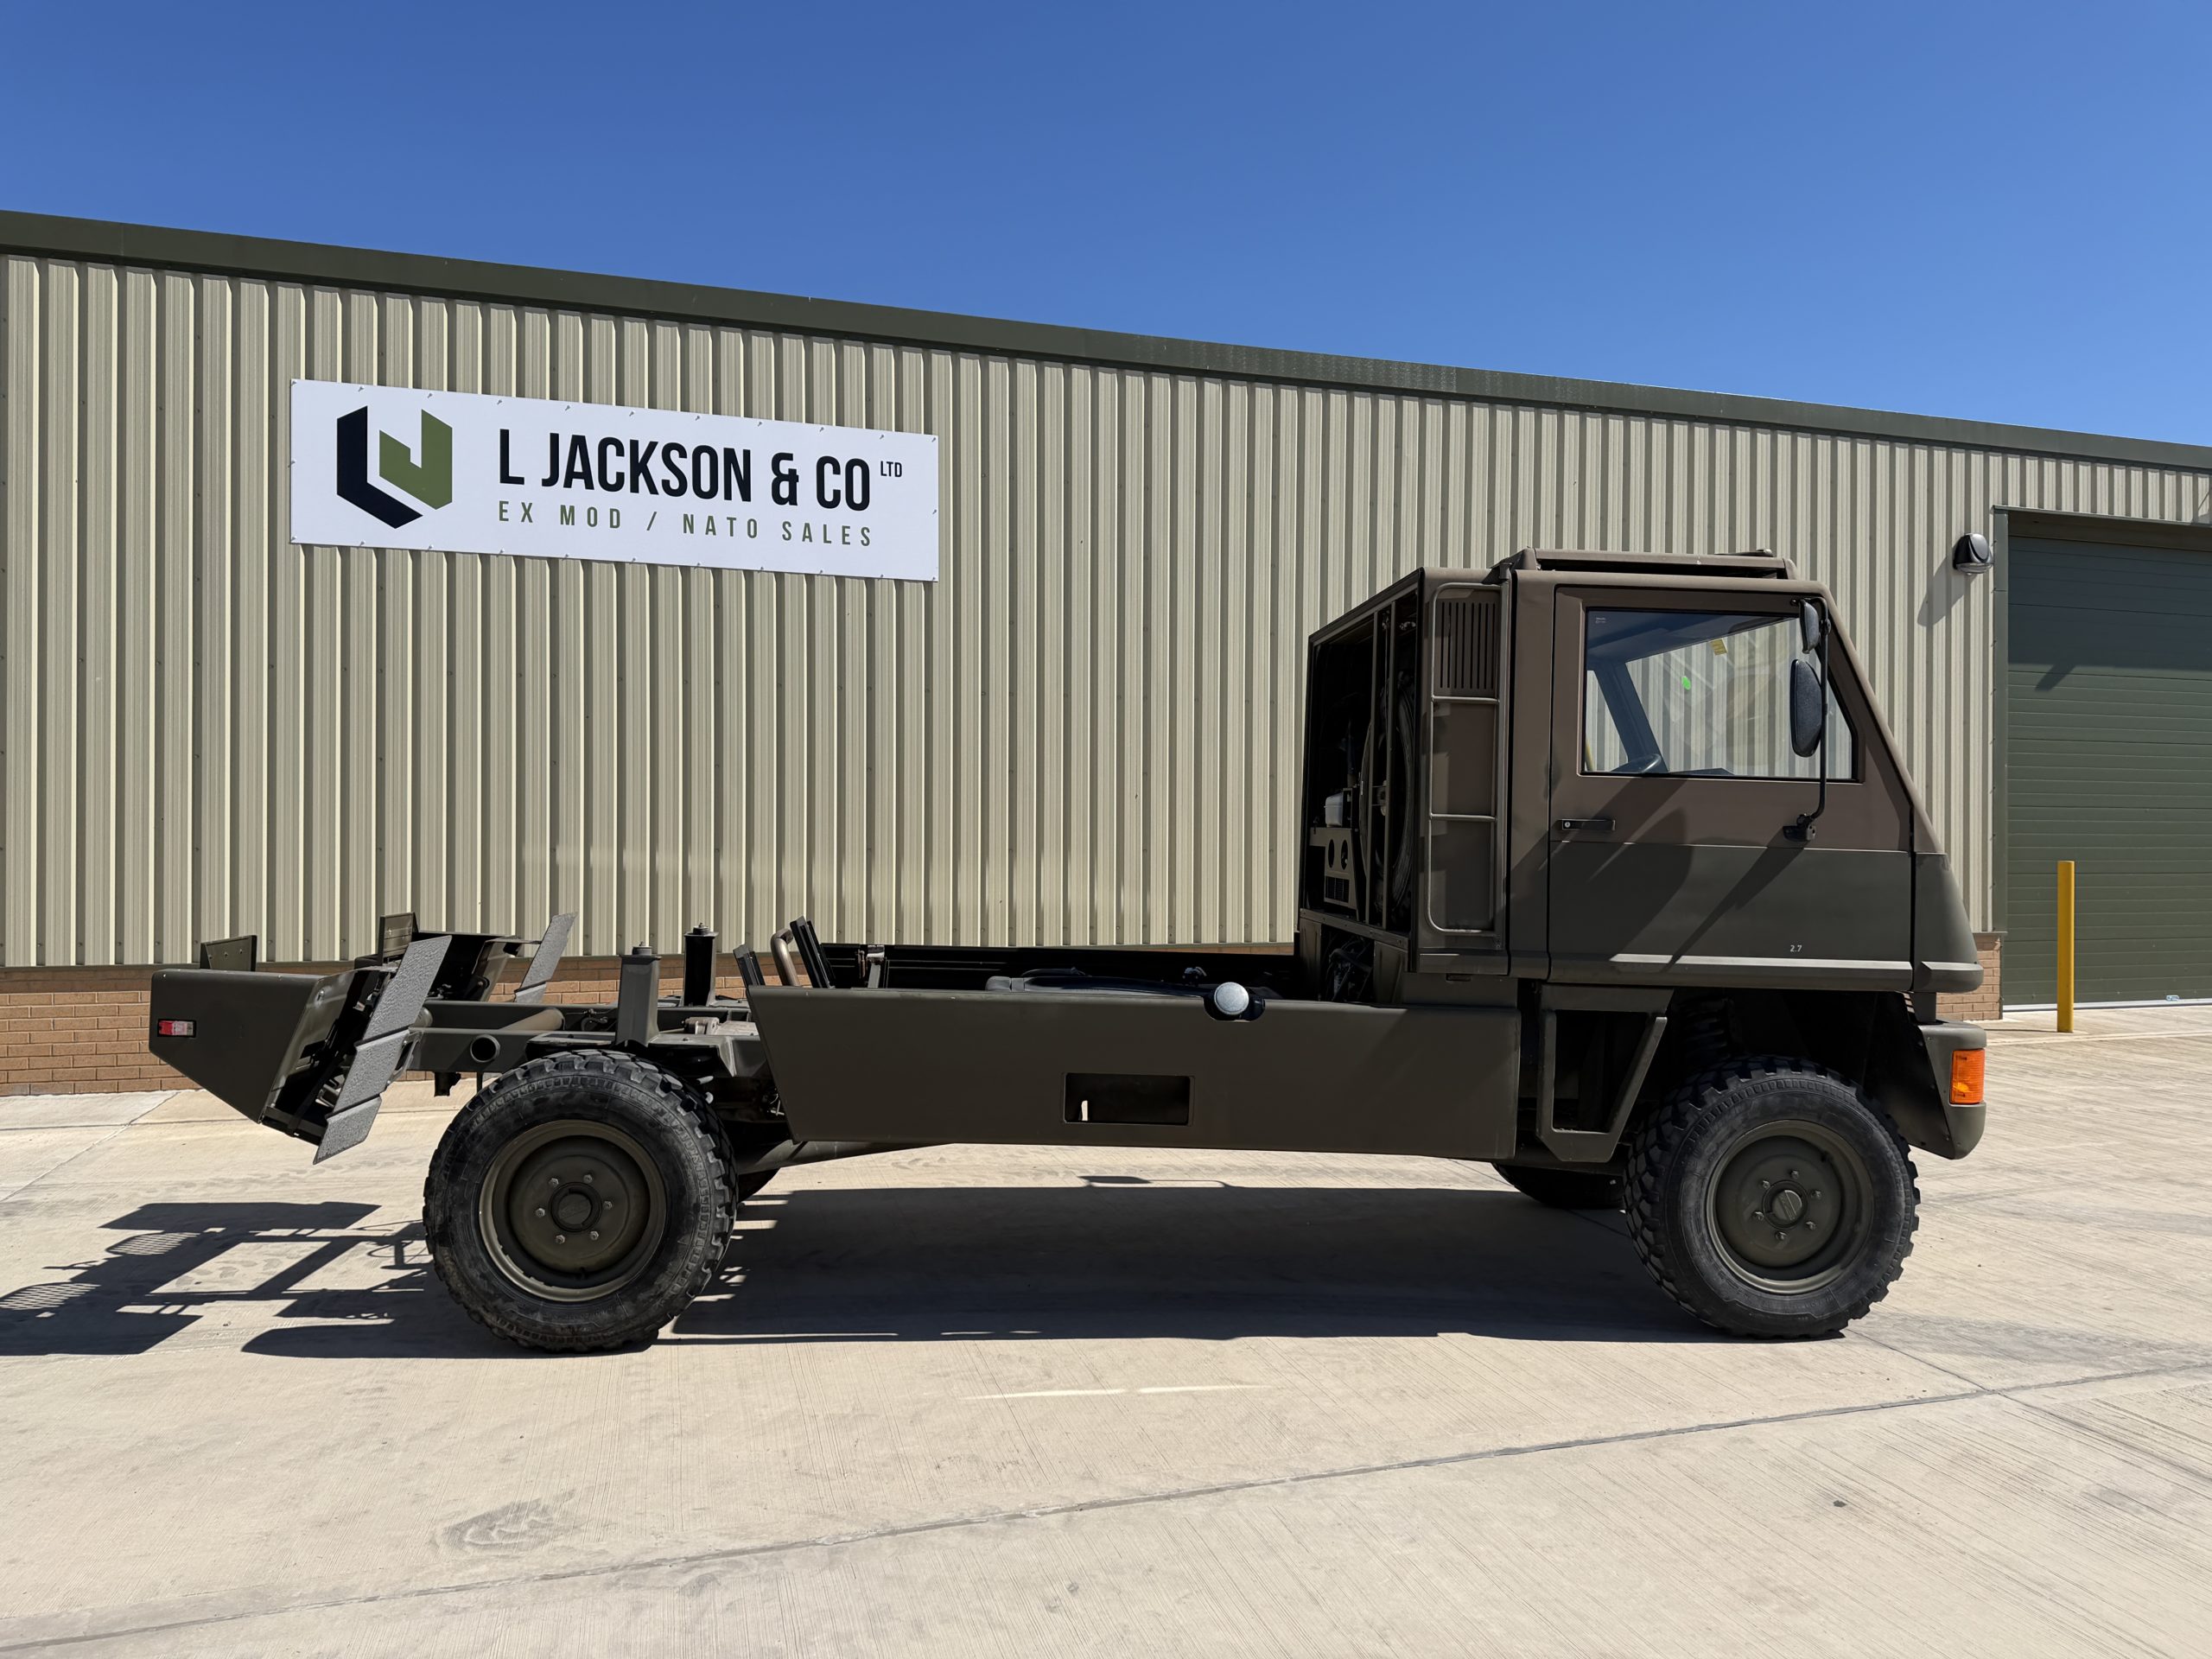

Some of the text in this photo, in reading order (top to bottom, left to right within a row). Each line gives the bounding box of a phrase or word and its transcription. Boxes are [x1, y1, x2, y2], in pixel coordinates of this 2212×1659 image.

[499, 429, 903, 512] L JACKSON & CO LTD
[499, 501, 870, 547] EX MOD / NATO SALES
